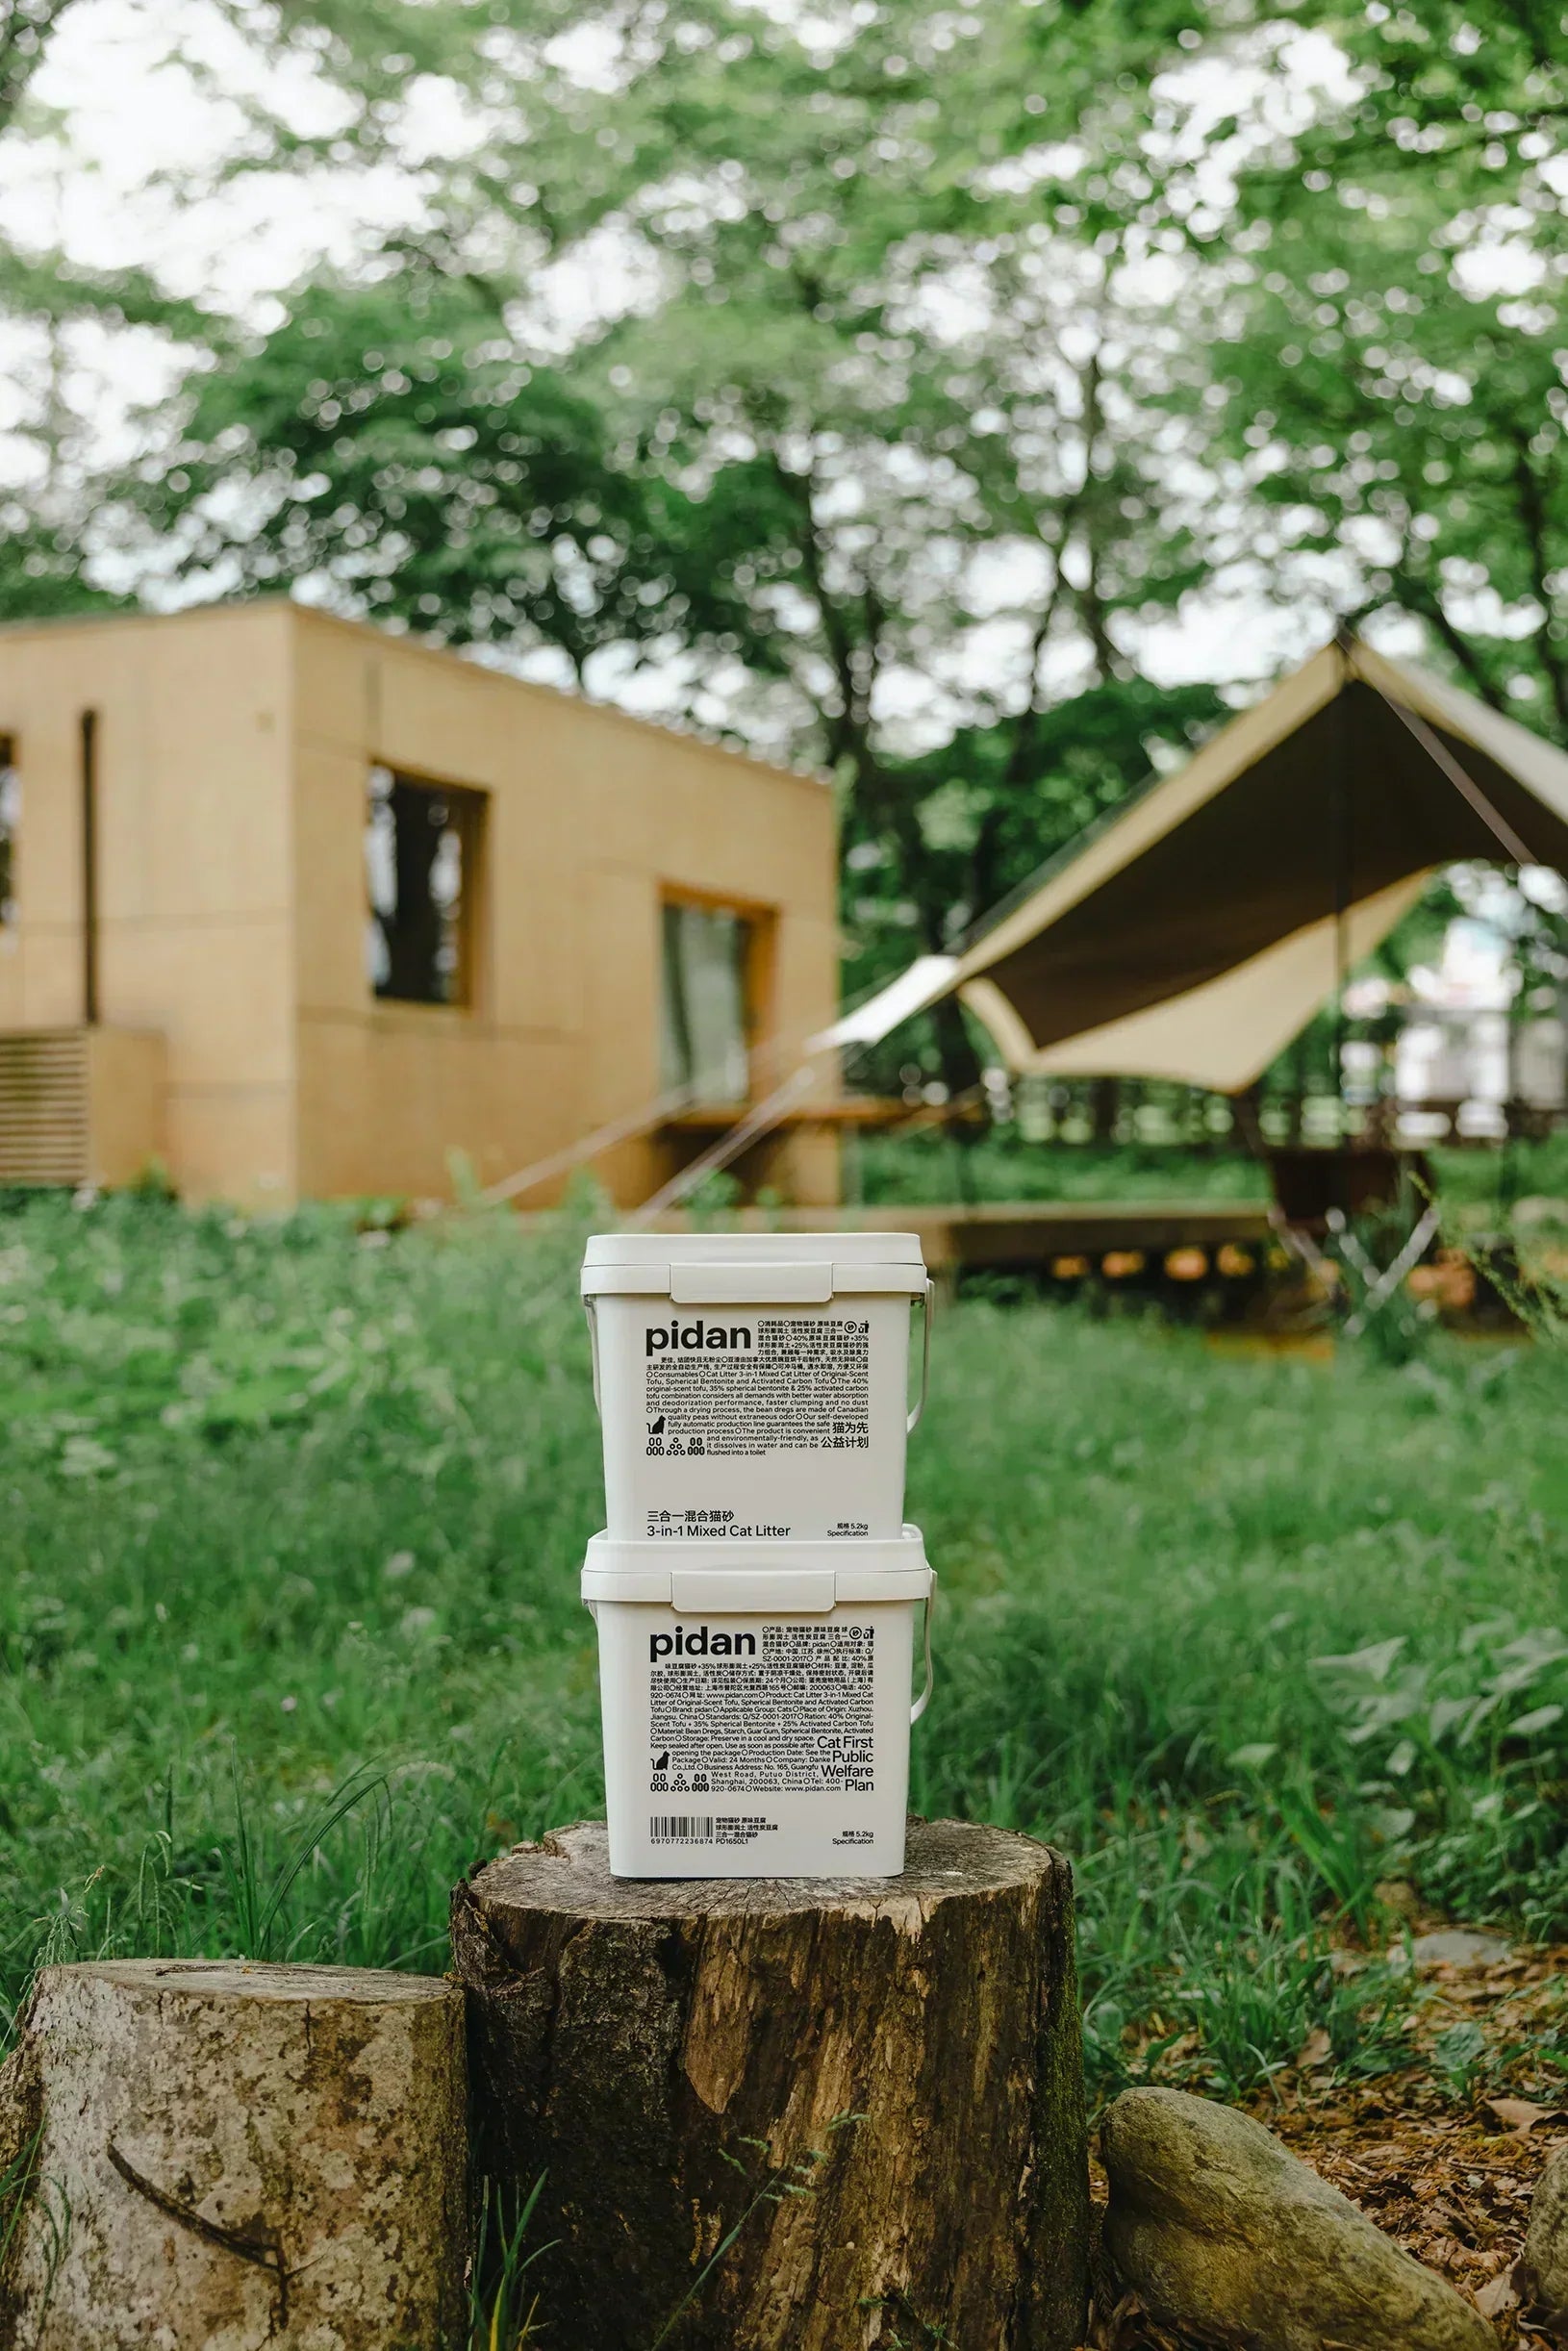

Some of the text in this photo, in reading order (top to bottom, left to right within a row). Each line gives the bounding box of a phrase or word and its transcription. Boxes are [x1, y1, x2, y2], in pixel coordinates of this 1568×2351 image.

[646, 1320, 750, 1356] pidan
[789, 1399, 823, 1407] clumping
[832, 1422, 869, 1433] 猫为先
[821, 1436, 869, 1448] 公益计划
[647, 1510, 734, 1522] 三合一混合猫砂
[647, 1525, 791, 1536] 3-in-1 Mixed Cat Litter
[650, 1626, 755, 1662] pidan
[753, 1706, 775, 1714] Group:
[818, 1735, 873, 1748] Cat First
[833, 1750, 873, 1762] Public
[821, 1764, 873, 1777] Welfare
[711, 1778, 746, 1786] Shanghai,
[748, 1778, 779, 1786] 200063,
[846, 1779, 873, 1791] Plan
